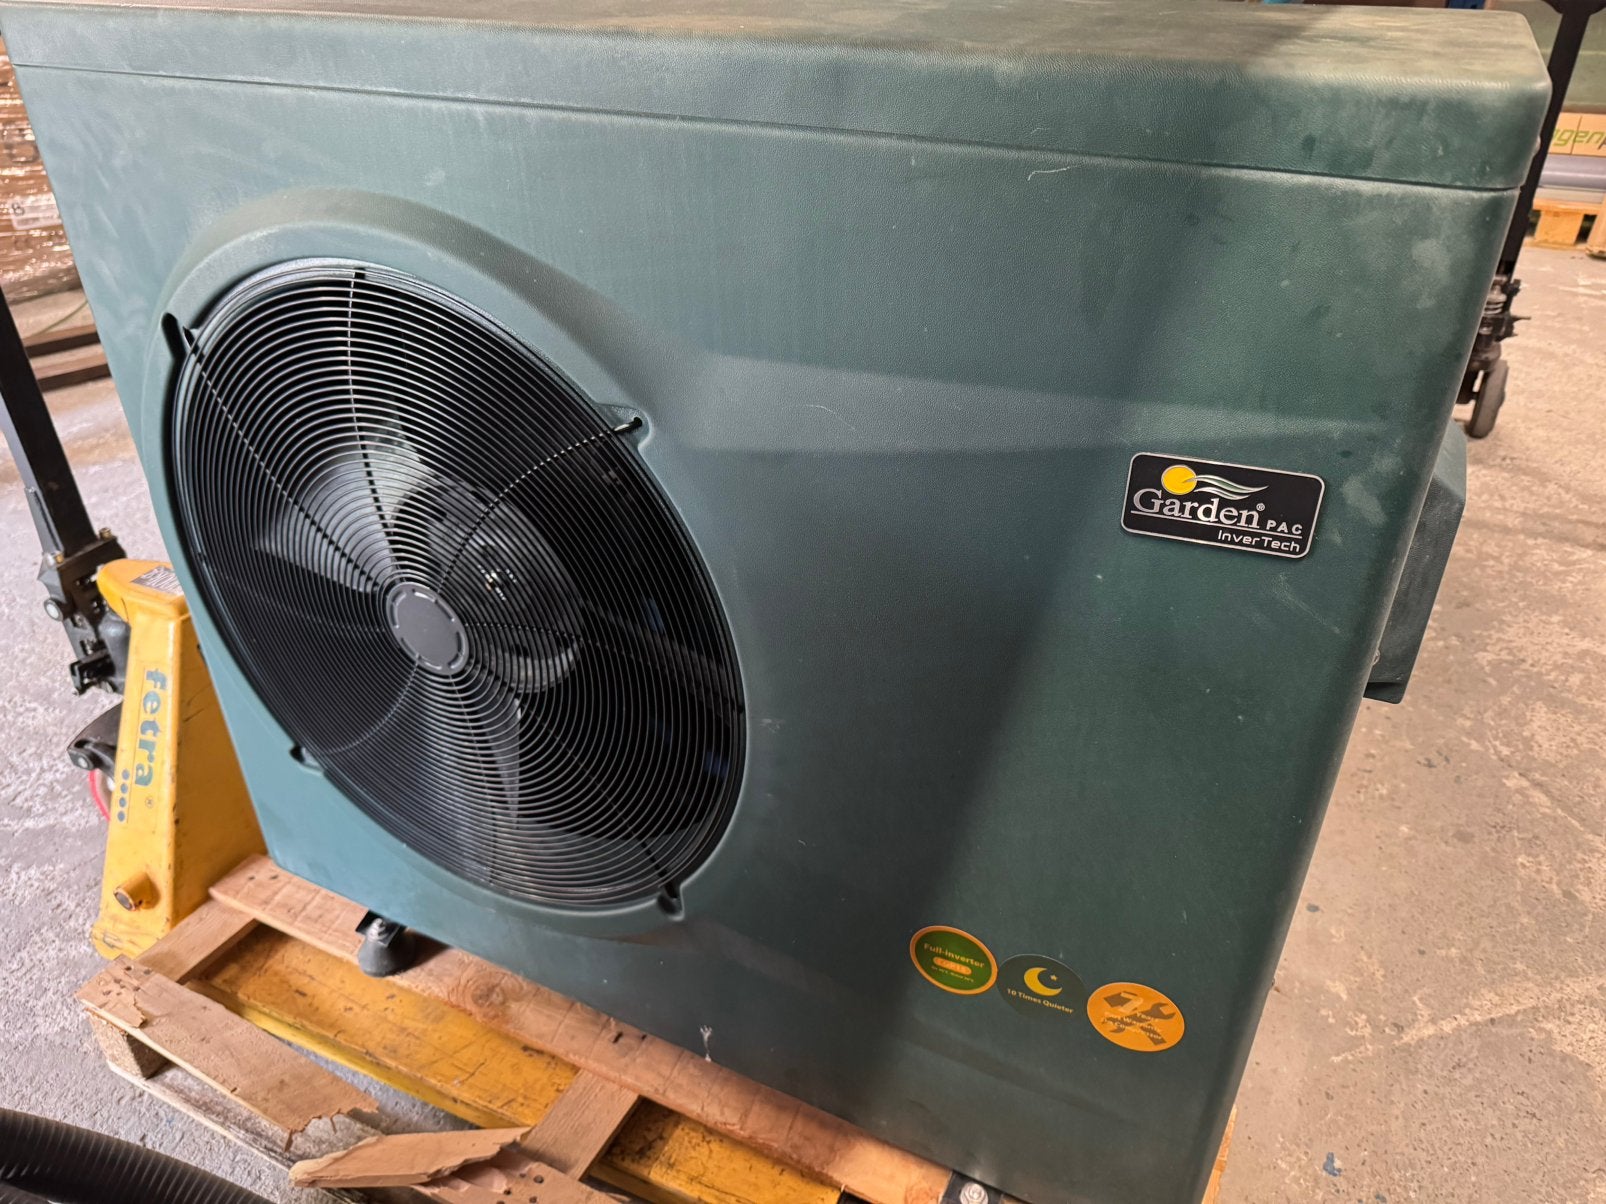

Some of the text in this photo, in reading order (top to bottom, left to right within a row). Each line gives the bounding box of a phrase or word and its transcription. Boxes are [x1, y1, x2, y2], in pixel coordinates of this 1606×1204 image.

[1552, 127, 1606, 150] gen
[1217, 529, 1300, 553] InverTech
[134, 669, 168, 787] fetra
[1007, 988, 1074, 1014] 10 Times Quieter
